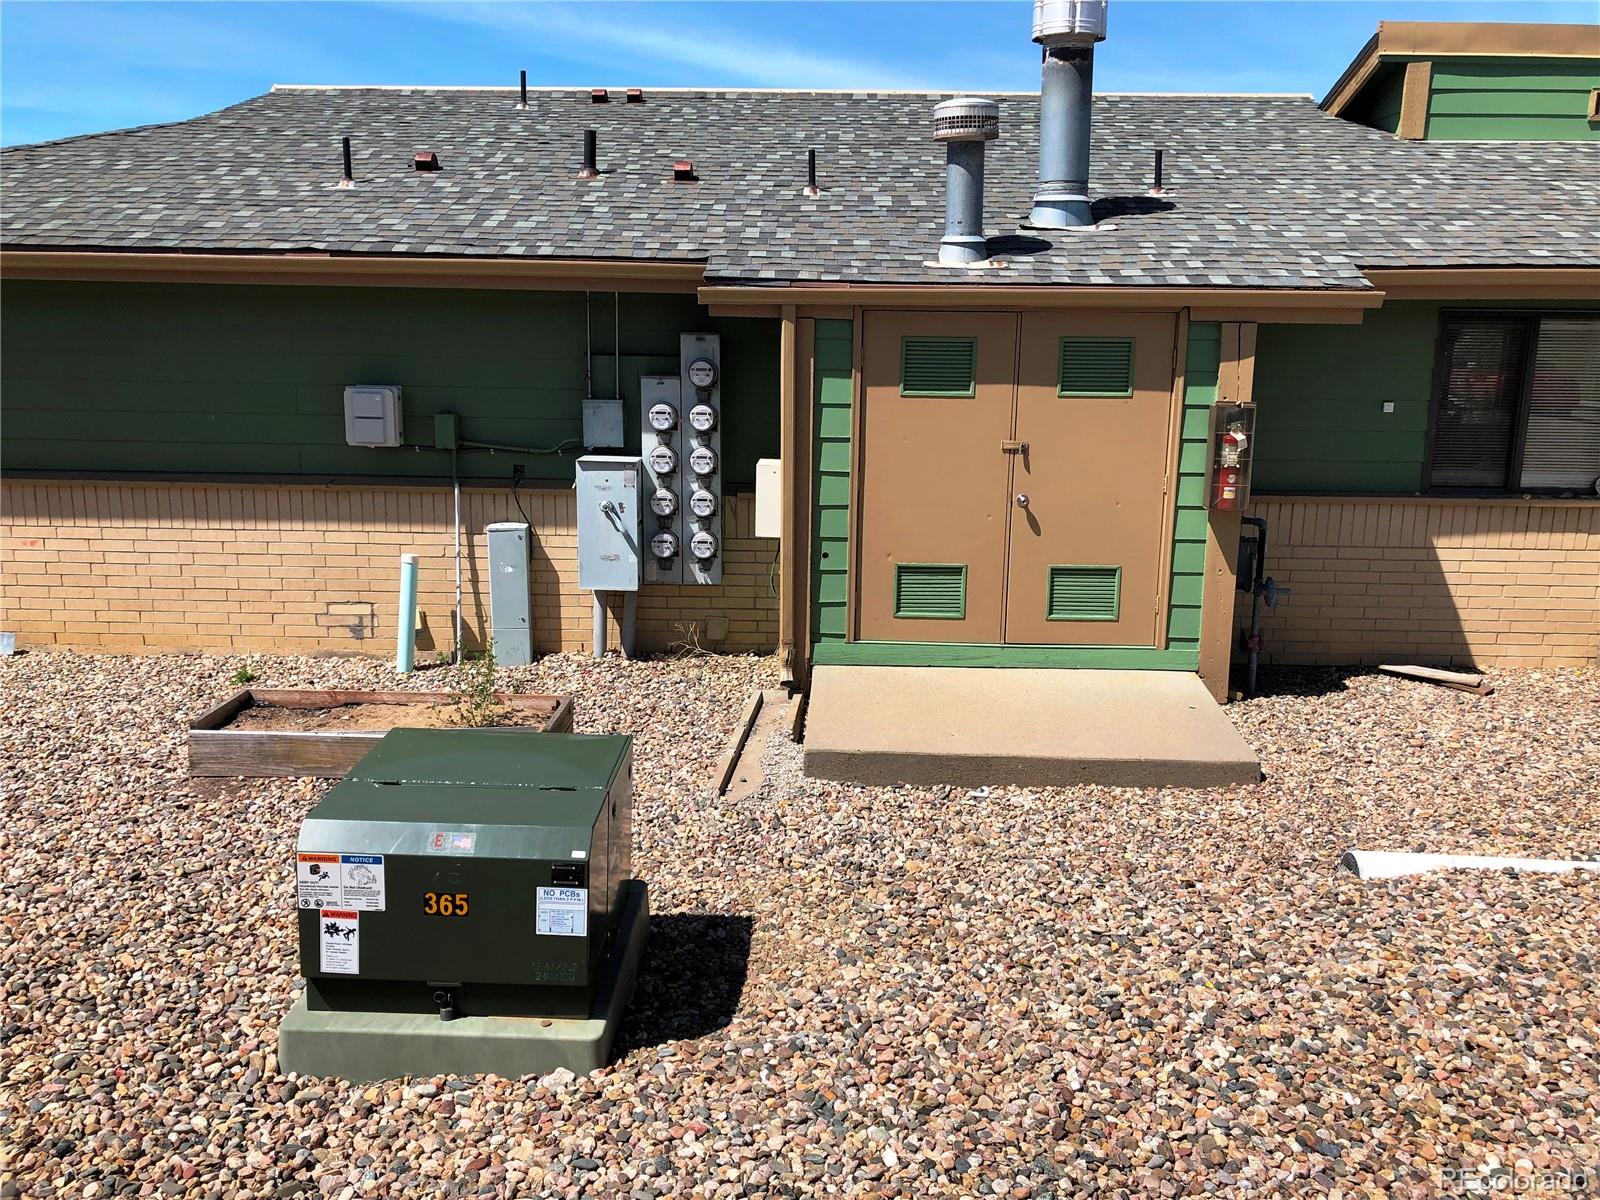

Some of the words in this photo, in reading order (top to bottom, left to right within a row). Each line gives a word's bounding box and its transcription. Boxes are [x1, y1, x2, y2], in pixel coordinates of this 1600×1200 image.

[543, 889, 556, 897] NO
[559, 890, 580, 898] PCBs
[424, 892, 468, 916] 365
[329, 910, 358, 919] WARNING
